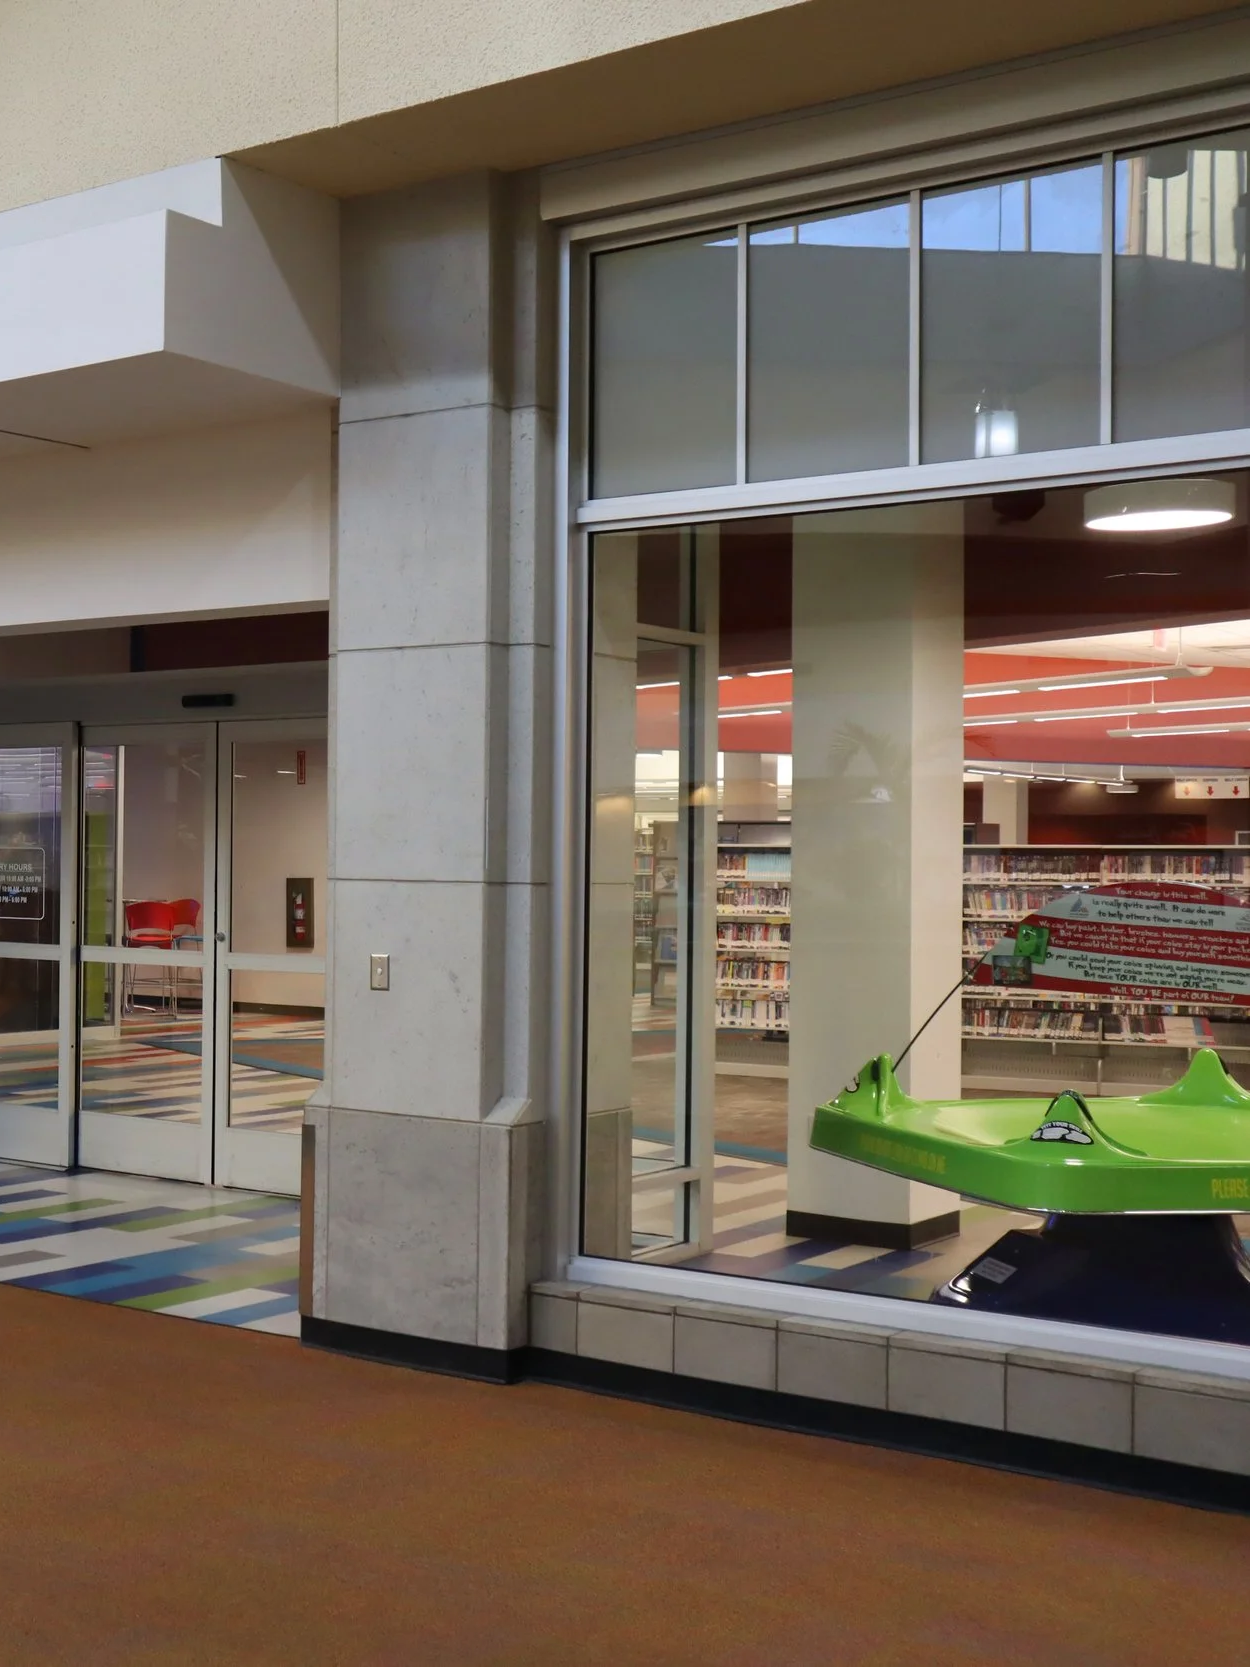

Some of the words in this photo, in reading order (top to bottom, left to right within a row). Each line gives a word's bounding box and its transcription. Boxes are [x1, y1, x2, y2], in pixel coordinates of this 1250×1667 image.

[9, 863, 32, 872] HOURS
[1115, 887, 1132, 895] Your
[1134, 889, 1161, 899] change
[1171, 891, 1188, 899] this
[1101, 899, 1122, 908] really
[1123, 901, 1143, 909] quite
[1196, 906, 1206, 914] do
[1108, 910, 1123, 920] help
[1125, 913, 1151, 921] others
[1199, 919, 1214, 928] tell
[1120, 935, 1137, 943] that
[1115, 973, 1137, 982] YOUR
[1182, 981, 1200, 989] OUR
[1191, 992, 1209, 1000] OUR
[1212, 1178, 1250, 1200] PLEASE
